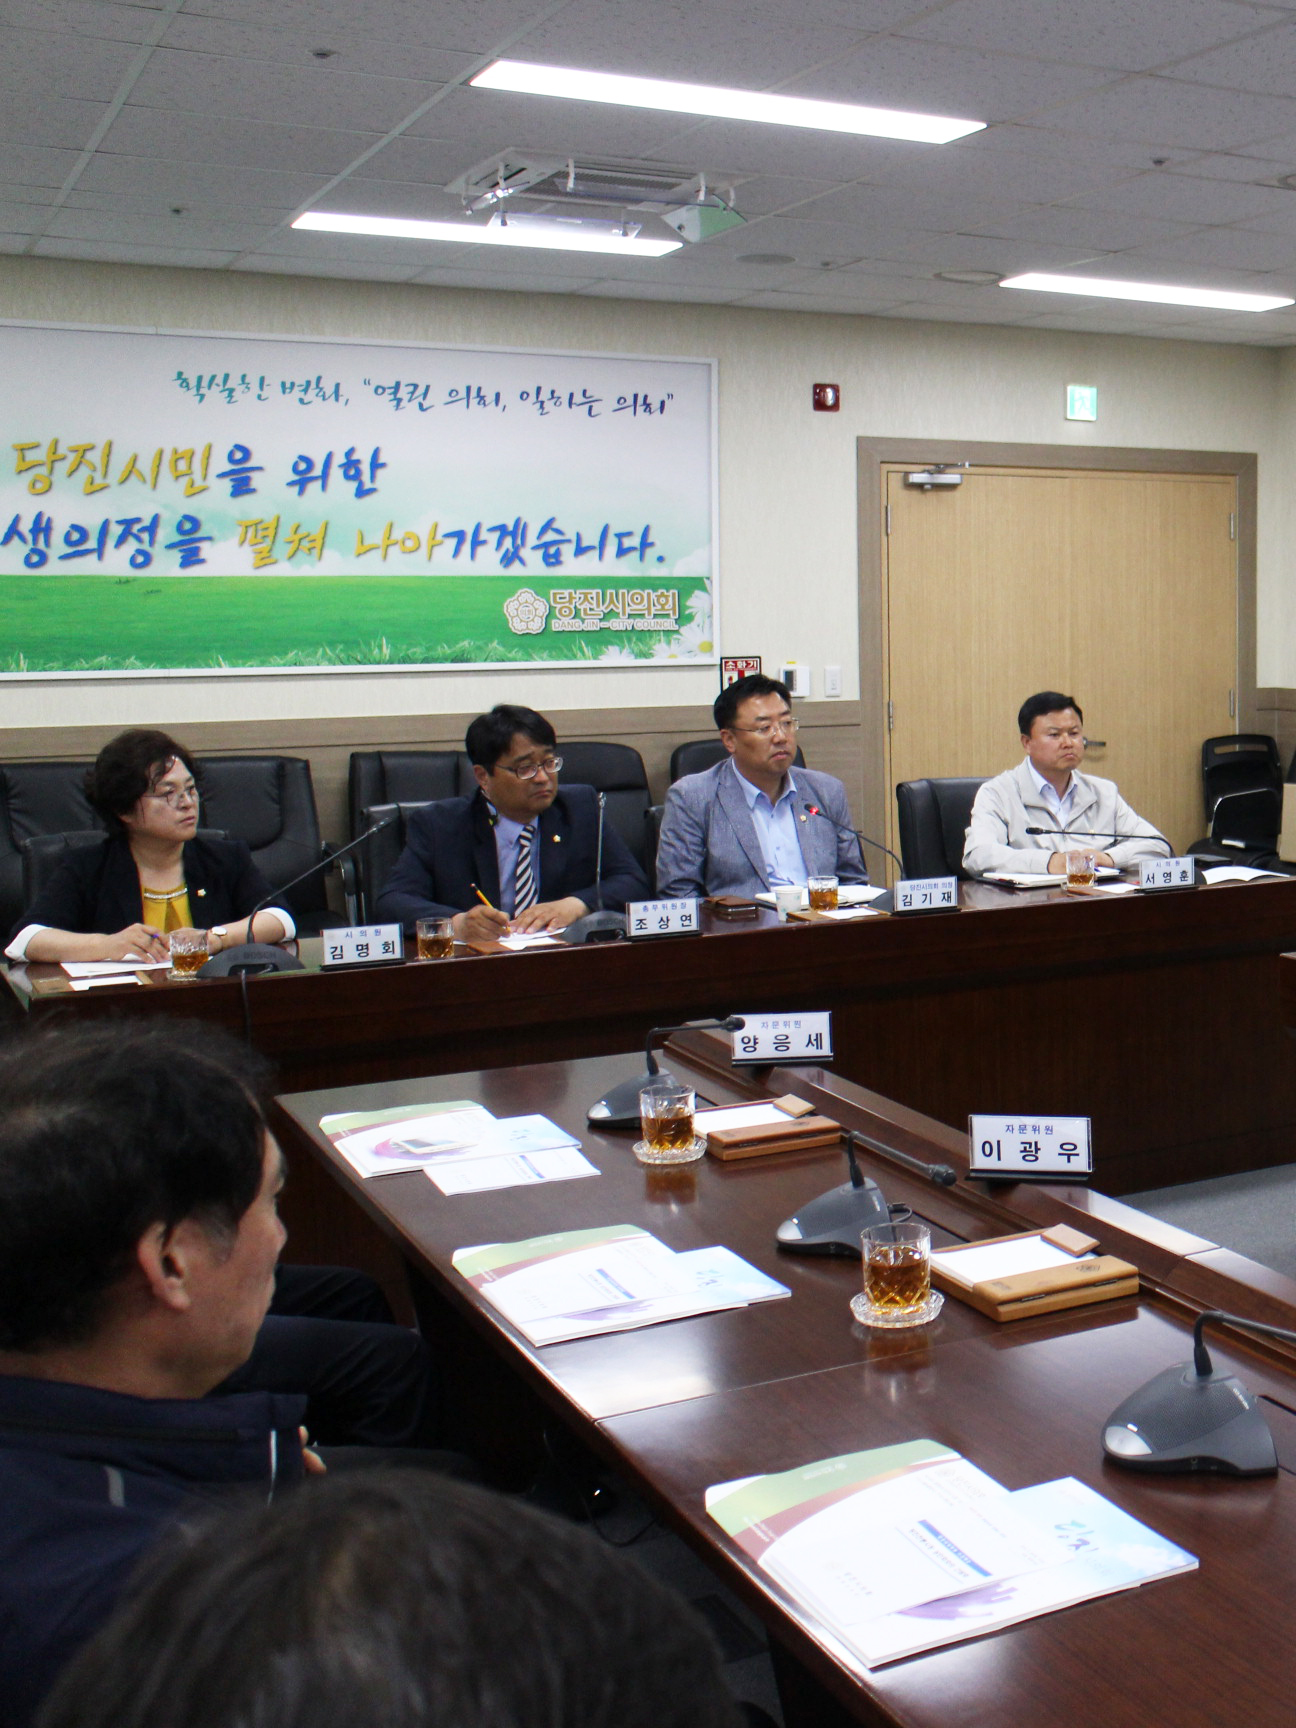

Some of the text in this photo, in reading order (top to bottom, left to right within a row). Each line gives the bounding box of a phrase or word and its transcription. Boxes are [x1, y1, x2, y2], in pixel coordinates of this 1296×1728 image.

[172, 370, 270, 405] 확실한
[280, 375, 349, 406] 변화,
[443, 385, 507, 412] 의회,
[519, 386, 602, 417] 일하는
[11, 437, 388, 499] 당진시민을 위한
[0, 511, 666, 569] 생의정을 펼쳐 나아가겠습니다.
[551, 589, 678, 618] 당진시의회
[552, 619, 581, 630] DANG
[582, 619, 599, 630] JIN
[610, 619, 634, 630] CITY
[635, 619, 679, 630] COUNCIL
[725, 660, 758, 670] 소화기
[909, 882, 939, 892] 당진시의회
[901, 890, 952, 907] 김기재
[635, 913, 693, 931] 조상연
[345, 928, 382, 939] 시의원
[740, 1032, 823, 1053] 양응세
[1004, 1123, 1054, 1136] 자문위원
[981, 1139, 1080, 1164] 이광우
